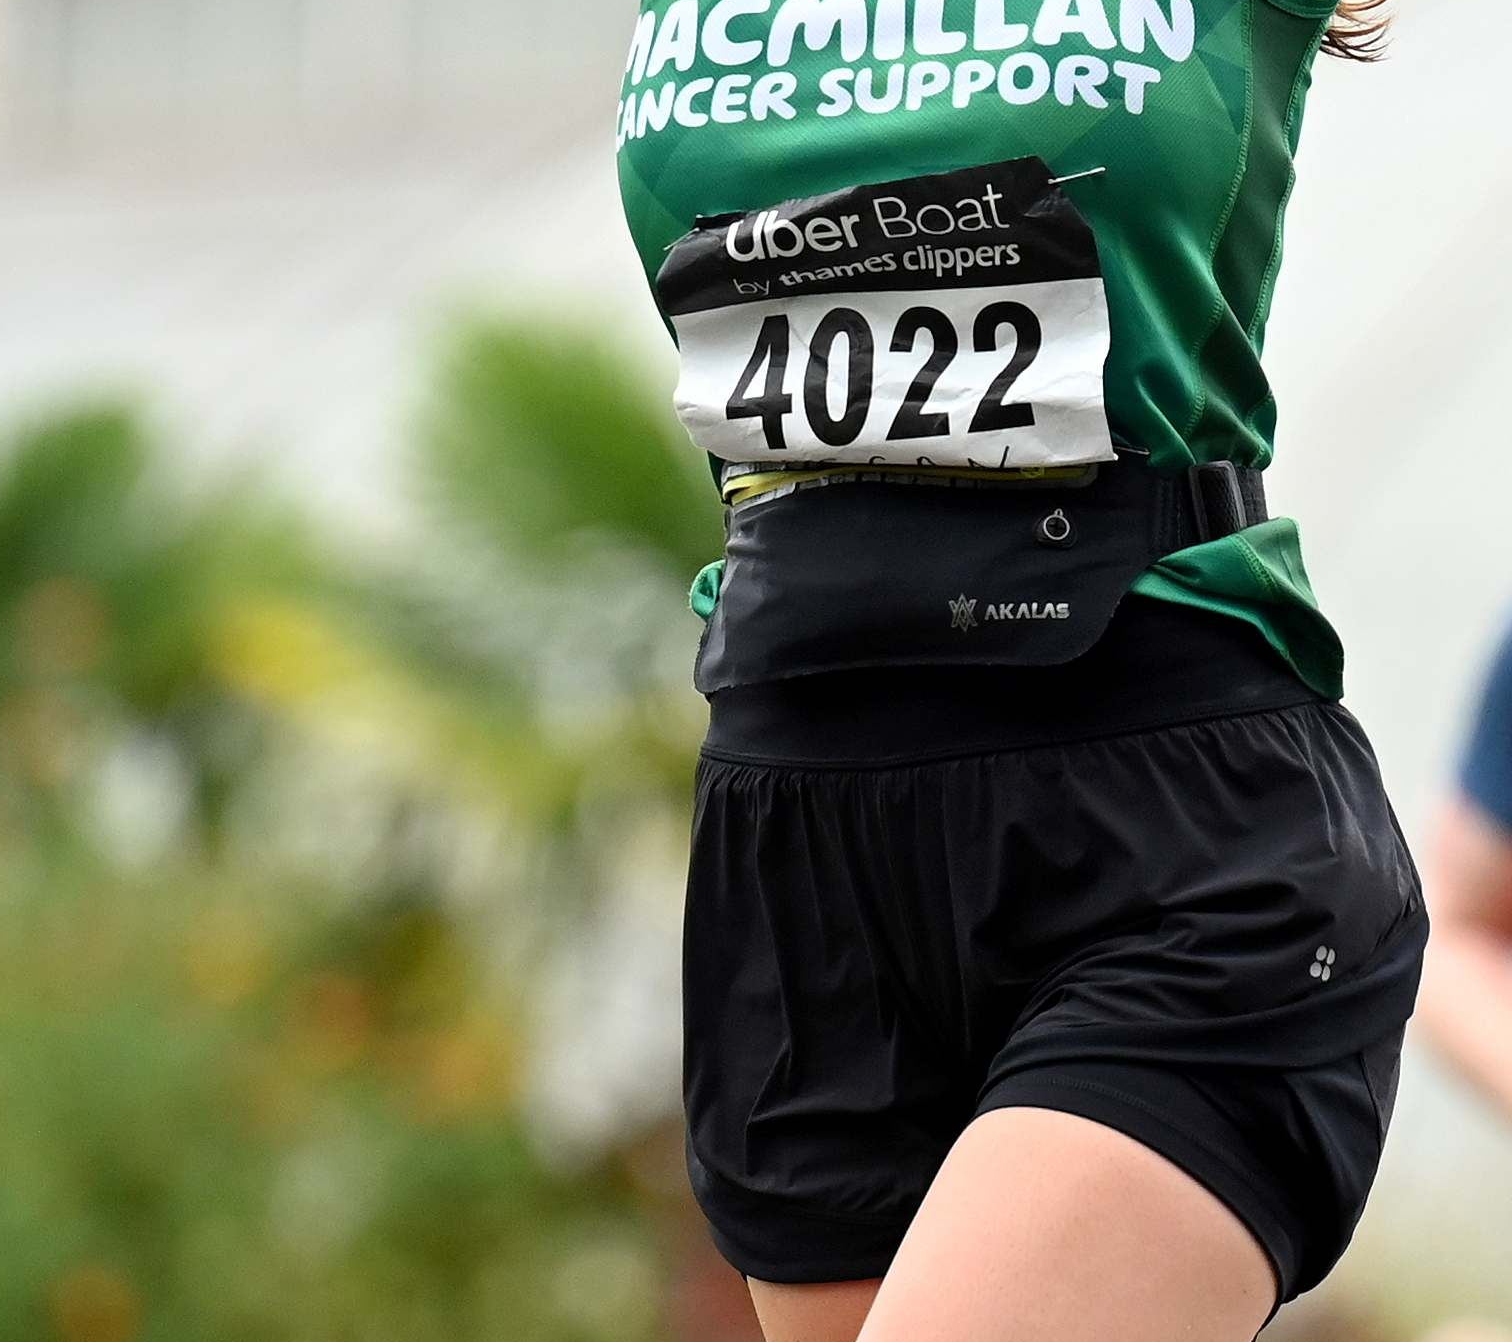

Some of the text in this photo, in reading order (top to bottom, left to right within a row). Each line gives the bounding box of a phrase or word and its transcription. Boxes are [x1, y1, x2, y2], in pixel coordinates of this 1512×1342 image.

[816, 52, 1161, 116] SUPPORT
[725, 183, 1010, 263] Uber Boat
[732, 243, 1021, 296] by thames clippers
[725, 301, 1042, 450] 4022
[984, 602, 1070, 621] AKALAS
